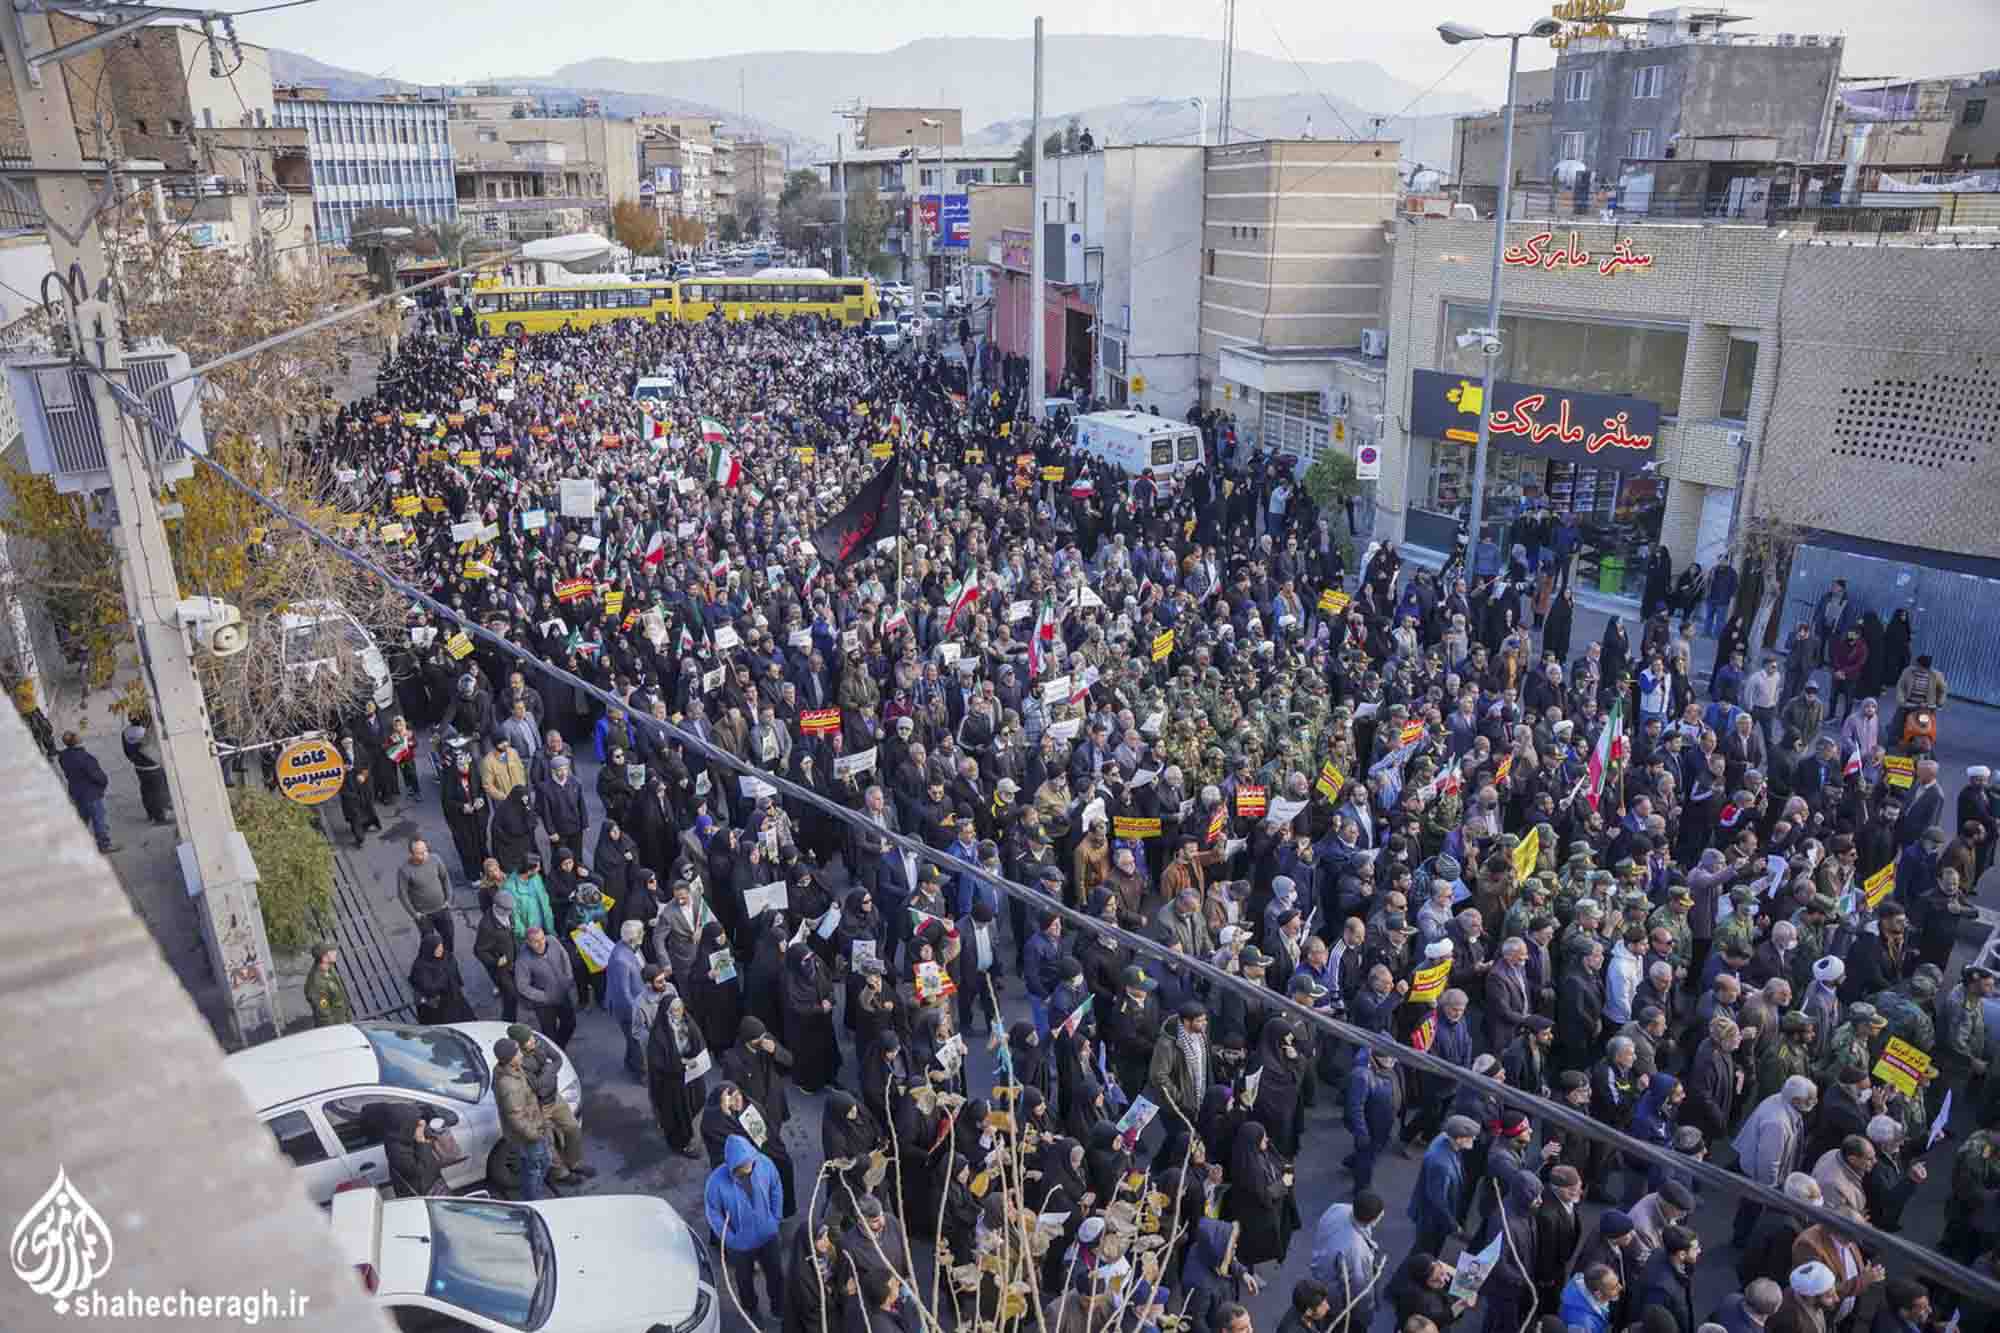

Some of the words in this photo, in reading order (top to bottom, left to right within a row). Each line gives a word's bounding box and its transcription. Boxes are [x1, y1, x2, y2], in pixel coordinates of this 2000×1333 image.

[1503, 232, 1590, 270] مارکت
[1599, 238, 1653, 276] سنتر
[1487, 394, 1584, 443] مارکت
[1587, 410, 1653, 454] سنتر
[292, 749, 327, 768] کافه
